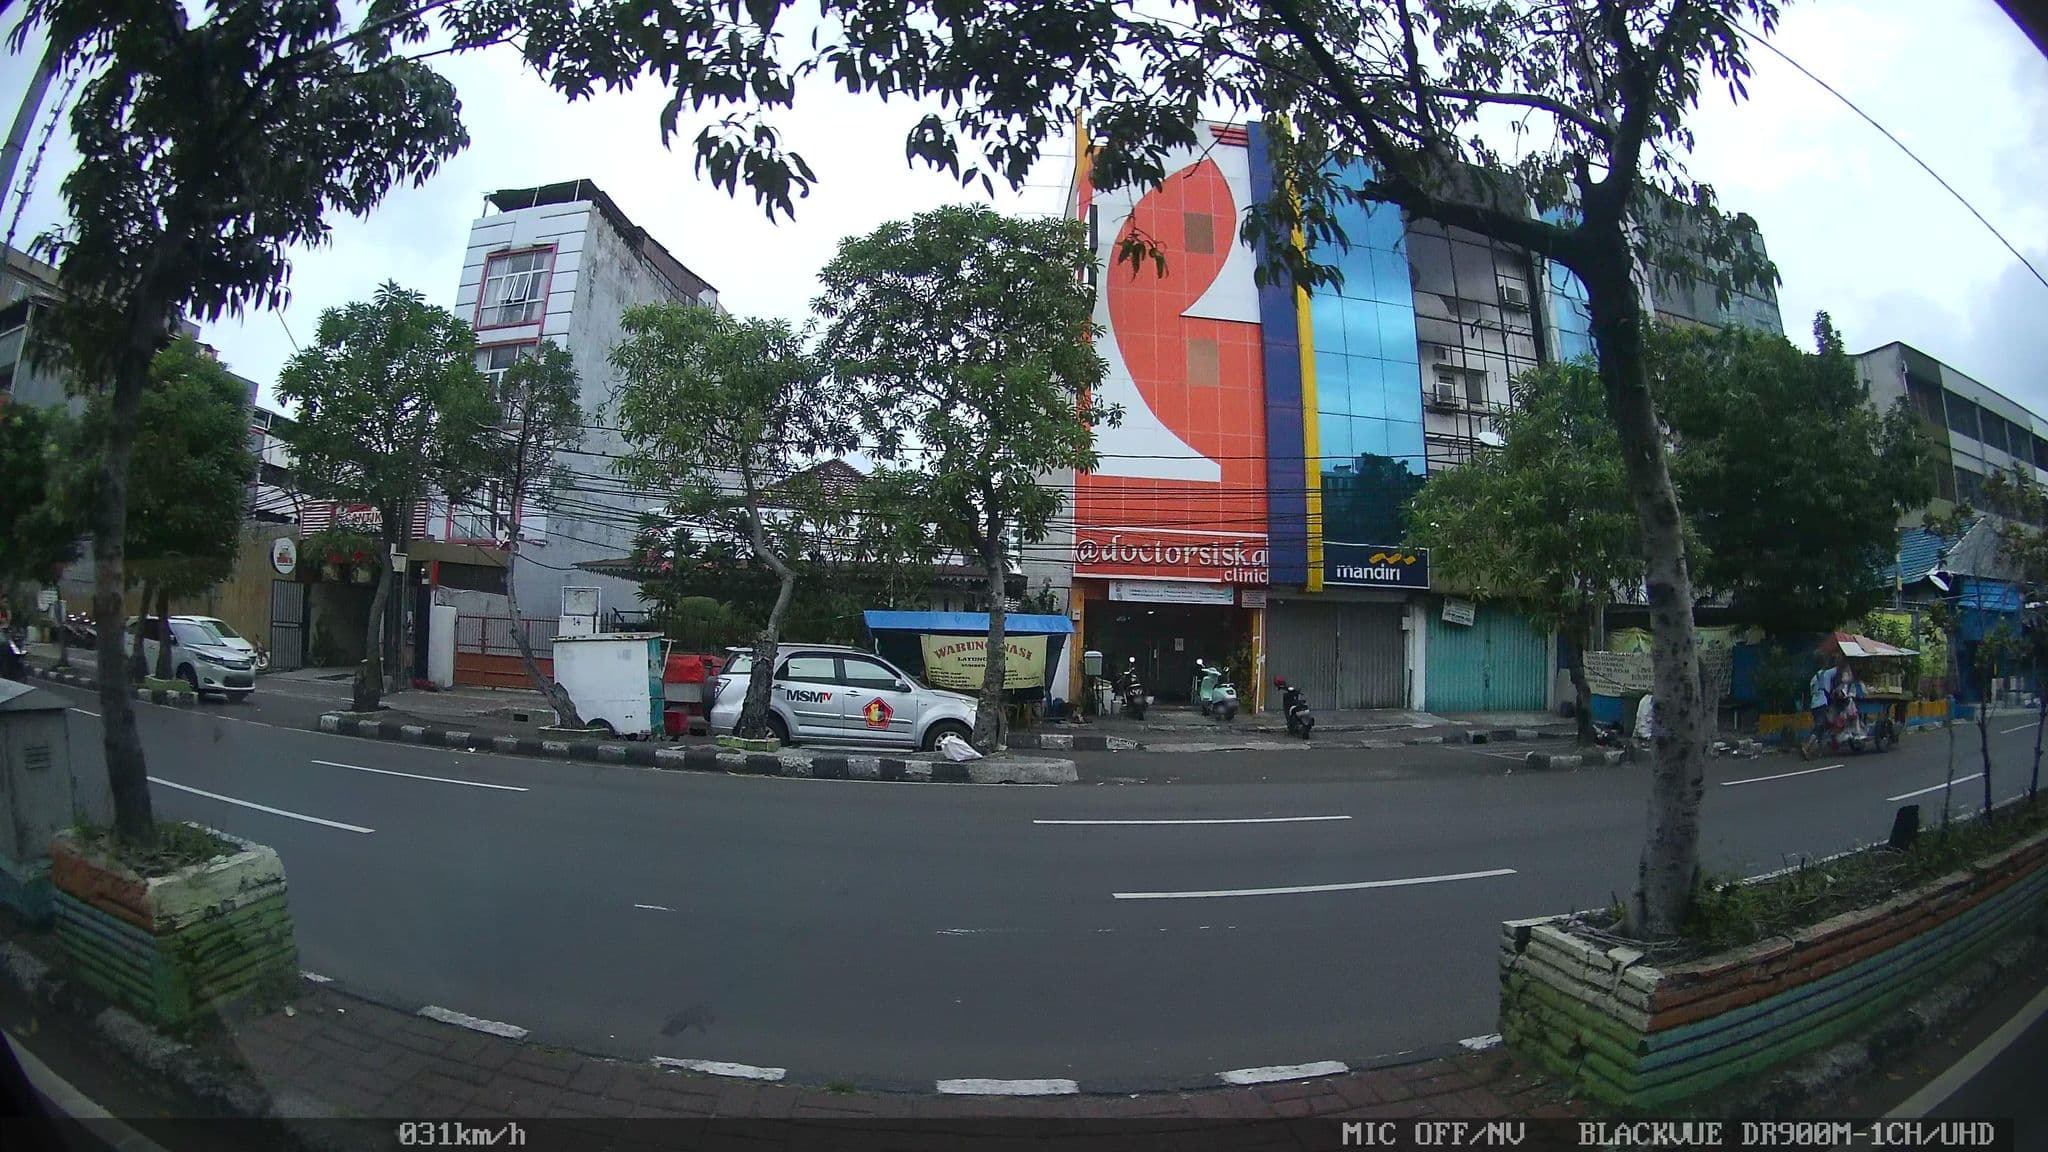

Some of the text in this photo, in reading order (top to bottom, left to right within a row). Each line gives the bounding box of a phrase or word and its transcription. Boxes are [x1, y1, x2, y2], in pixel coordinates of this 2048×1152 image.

[1074, 534, 1268, 568] @doctorsiska
[1223, 567, 1268, 584] clinic
[1336, 563, 1401, 581] mandiri
[934, 641, 988, 659] WARUN
